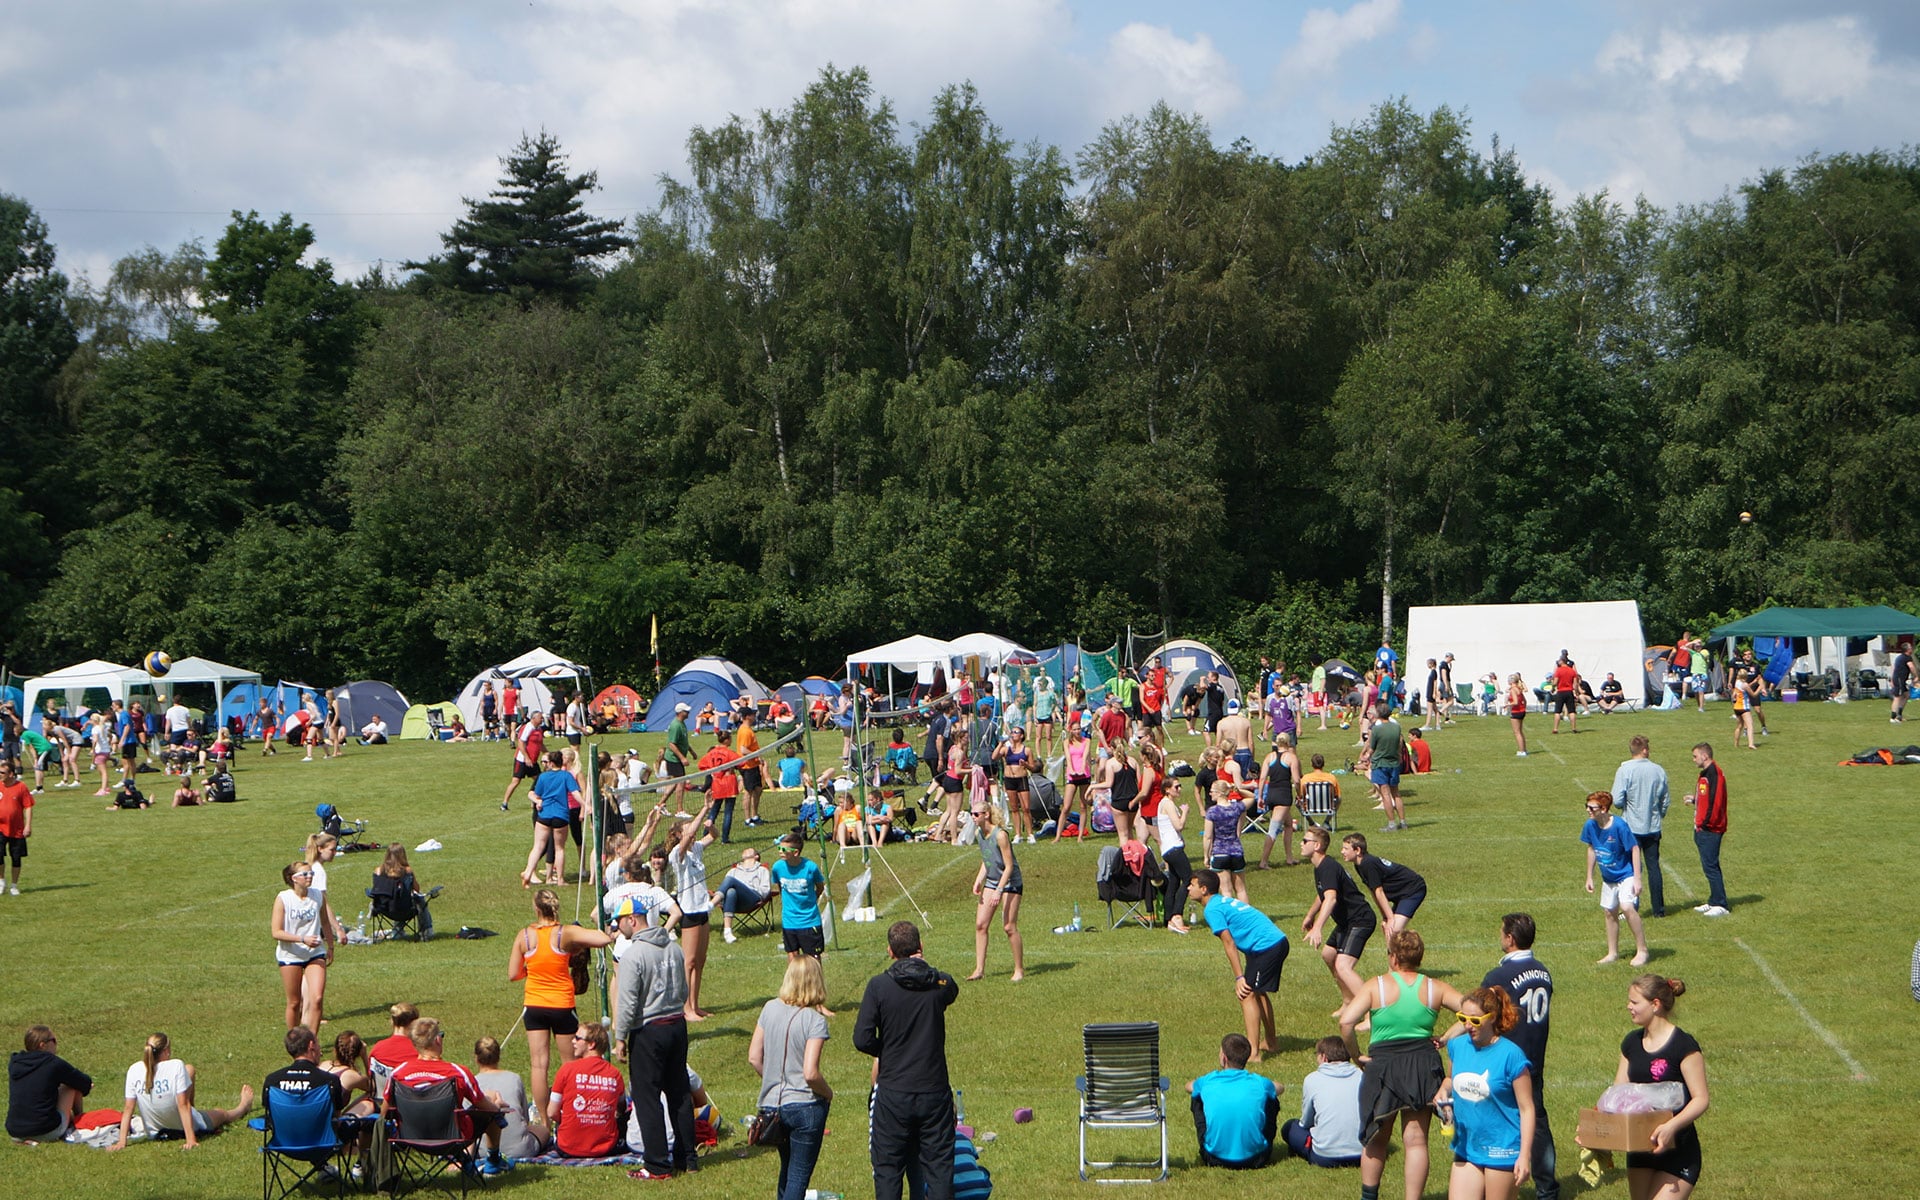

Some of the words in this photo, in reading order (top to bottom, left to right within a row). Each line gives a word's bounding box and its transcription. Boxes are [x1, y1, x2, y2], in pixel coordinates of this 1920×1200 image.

[622, 895, 654, 908] CP33
[1519, 987, 1548, 1023] 10
[134, 1079, 170, 1095] CA33
[280, 1081, 311, 1091] THAT.
